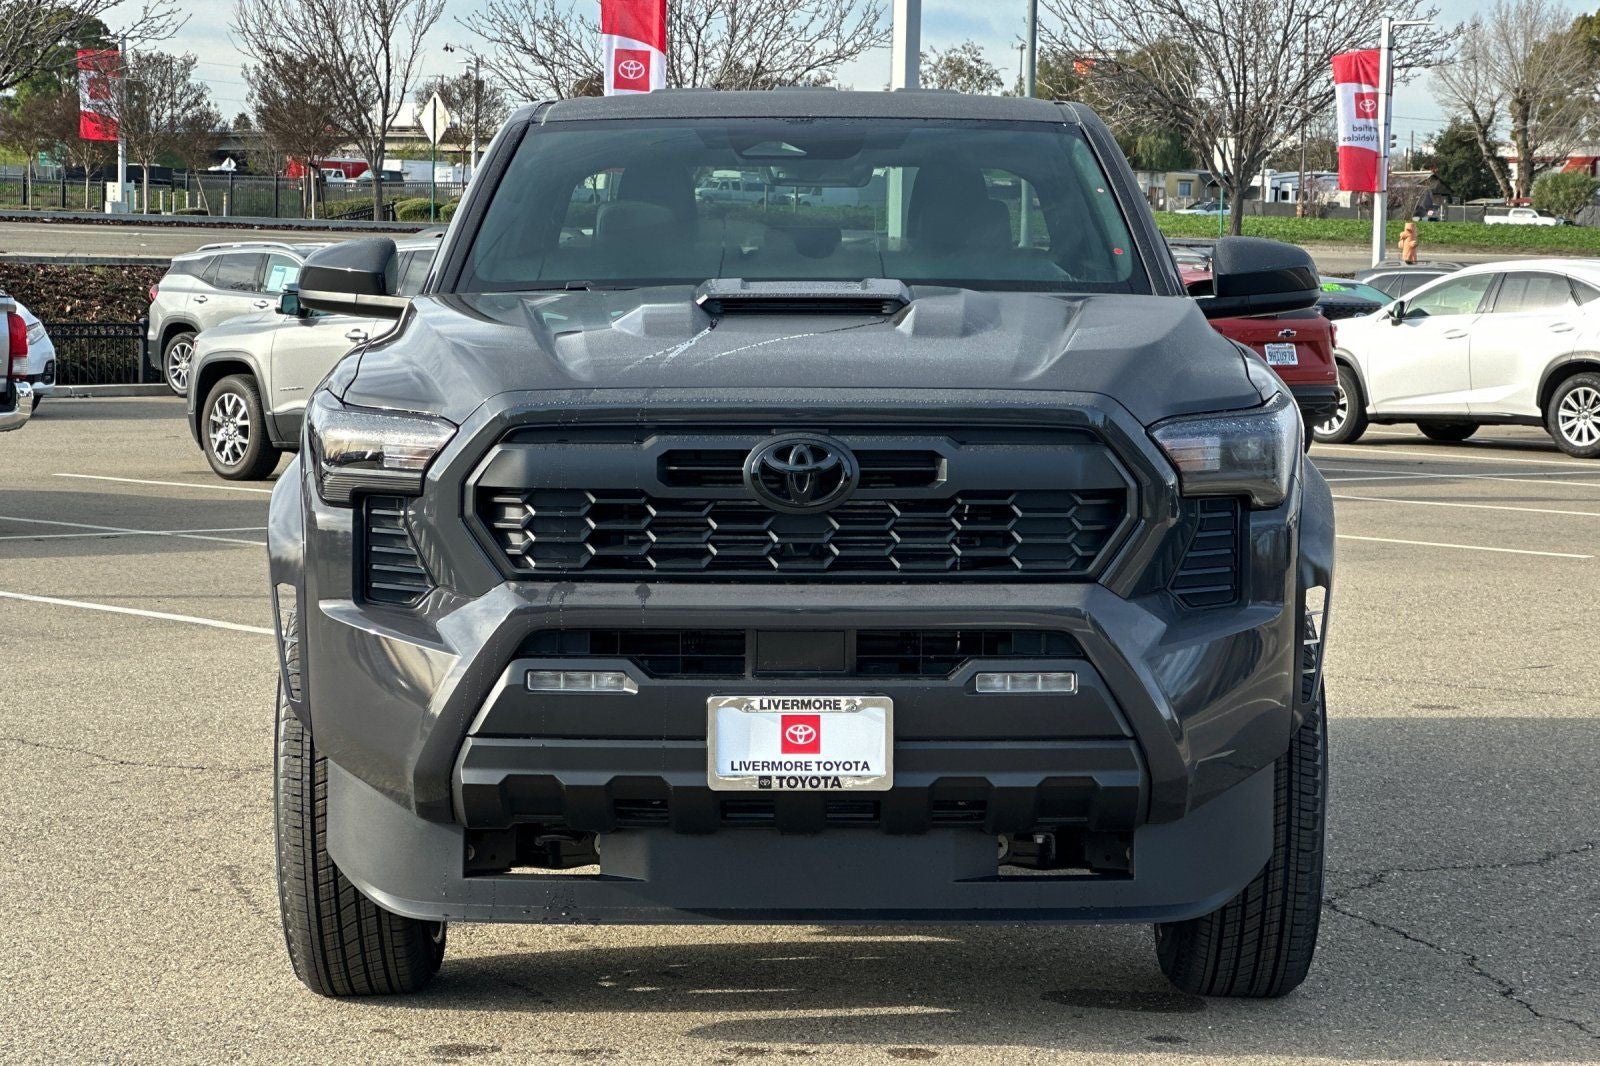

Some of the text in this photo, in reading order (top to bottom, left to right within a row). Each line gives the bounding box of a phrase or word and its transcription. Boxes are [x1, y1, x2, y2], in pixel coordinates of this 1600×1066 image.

[760, 699, 842, 710] LIVERMORE
[731, 761, 870, 771] LIVERMORE TOYOTA
[776, 775, 842, 789] TOYOTA
